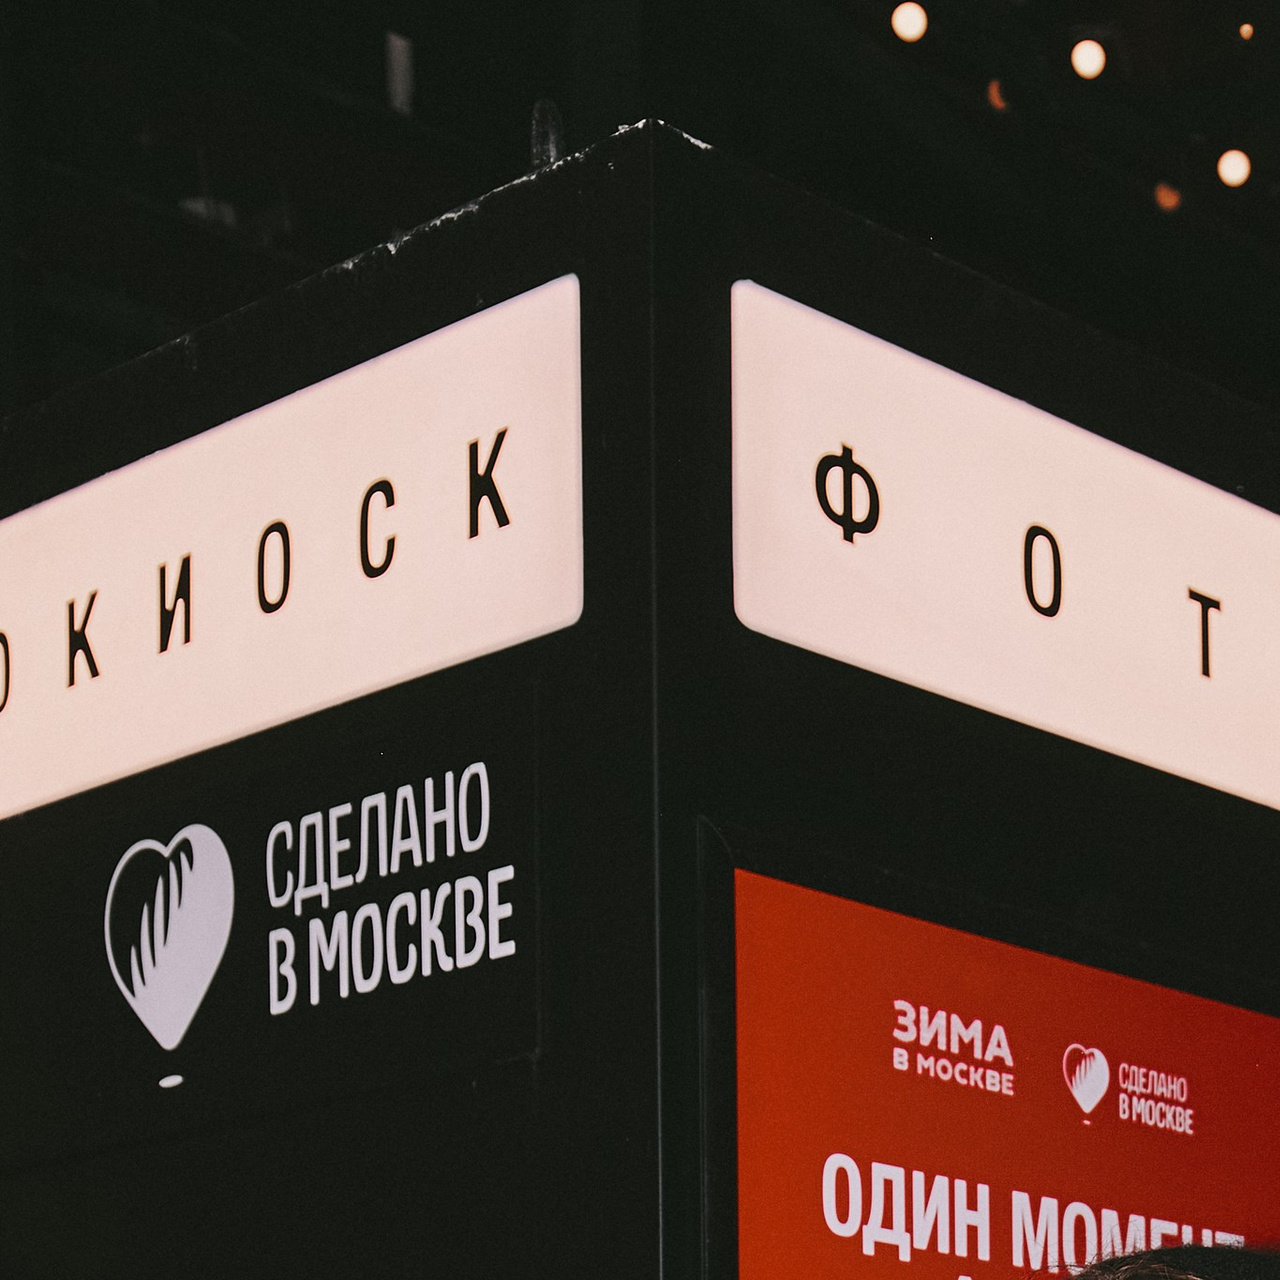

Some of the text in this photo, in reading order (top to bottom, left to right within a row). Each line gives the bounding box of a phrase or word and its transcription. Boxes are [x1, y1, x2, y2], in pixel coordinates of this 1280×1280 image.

[266, 761, 490, 917] СДЕЛАНО
[268, 864, 516, 1016] В МОСКВЕ
[892, 999, 1014, 1067] ЗИМА
[892, 1046, 1015, 1096] В МОСКВЕ
[1118, 1062, 1188, 1103] СДЕЛАНО
[1118, 1092, 1194, 1136] В МОСКВЕ
[822, 1152, 1246, 1276] ОДИН МОМ
